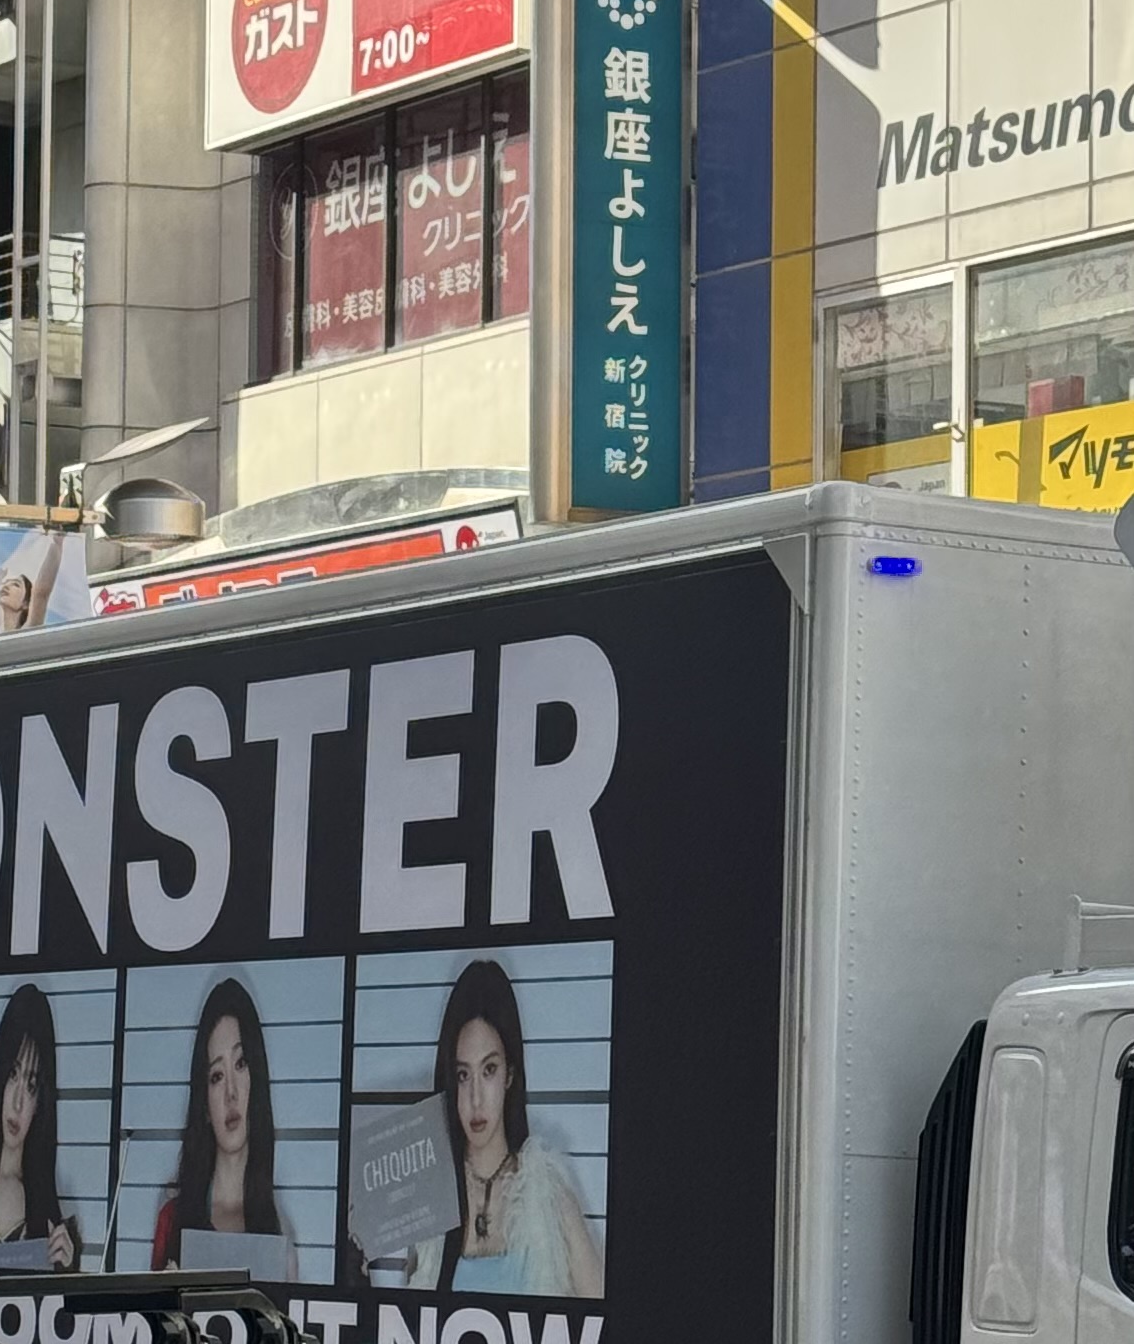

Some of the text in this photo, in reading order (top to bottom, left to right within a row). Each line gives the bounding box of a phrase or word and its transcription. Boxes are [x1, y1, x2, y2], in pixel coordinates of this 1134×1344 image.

[603, 46, 652, 336] 銀座よしえ
[602, 356, 628, 476] 新宿院
[627, 354, 651, 481] クリニック
[363, 1136, 437, 1192] CHIQUITA
